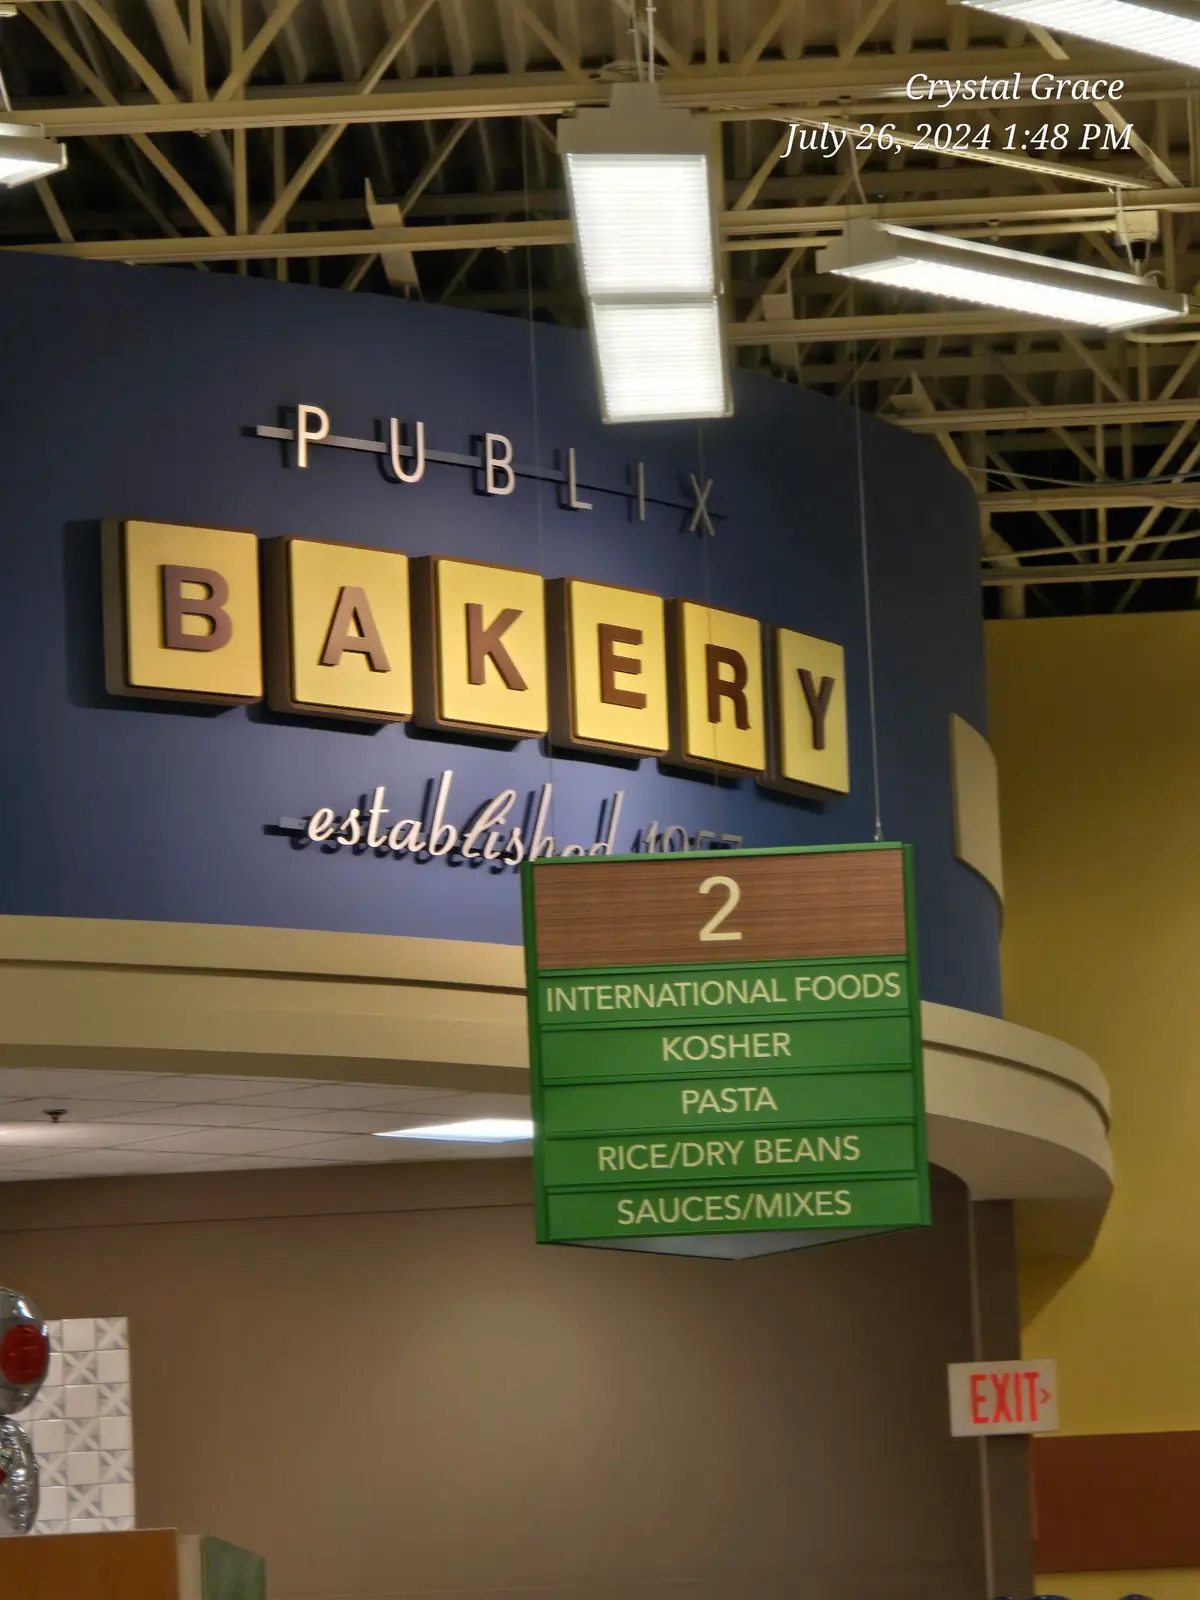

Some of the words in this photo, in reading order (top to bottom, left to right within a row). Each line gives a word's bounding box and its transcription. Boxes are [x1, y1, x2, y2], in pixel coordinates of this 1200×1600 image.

[296, 403, 716, 538] PUBLIX
[161, 563, 836, 751] BAKERY
[699, 875, 743, 942] 2
[545, 977, 787, 1013] INTERNATIONAL
[795, 972, 902, 1001] FOODS
[661, 1032, 792, 1062] KOSHER
[680, 1086, 778, 1115] PASTA
[597, 1140, 745, 1172] RICE/DRY
[753, 1134, 861, 1165] BEANS
[616, 1189, 852, 1226] SAUCES/MIXES
[970, 1371, 1041, 1424] EXIT
